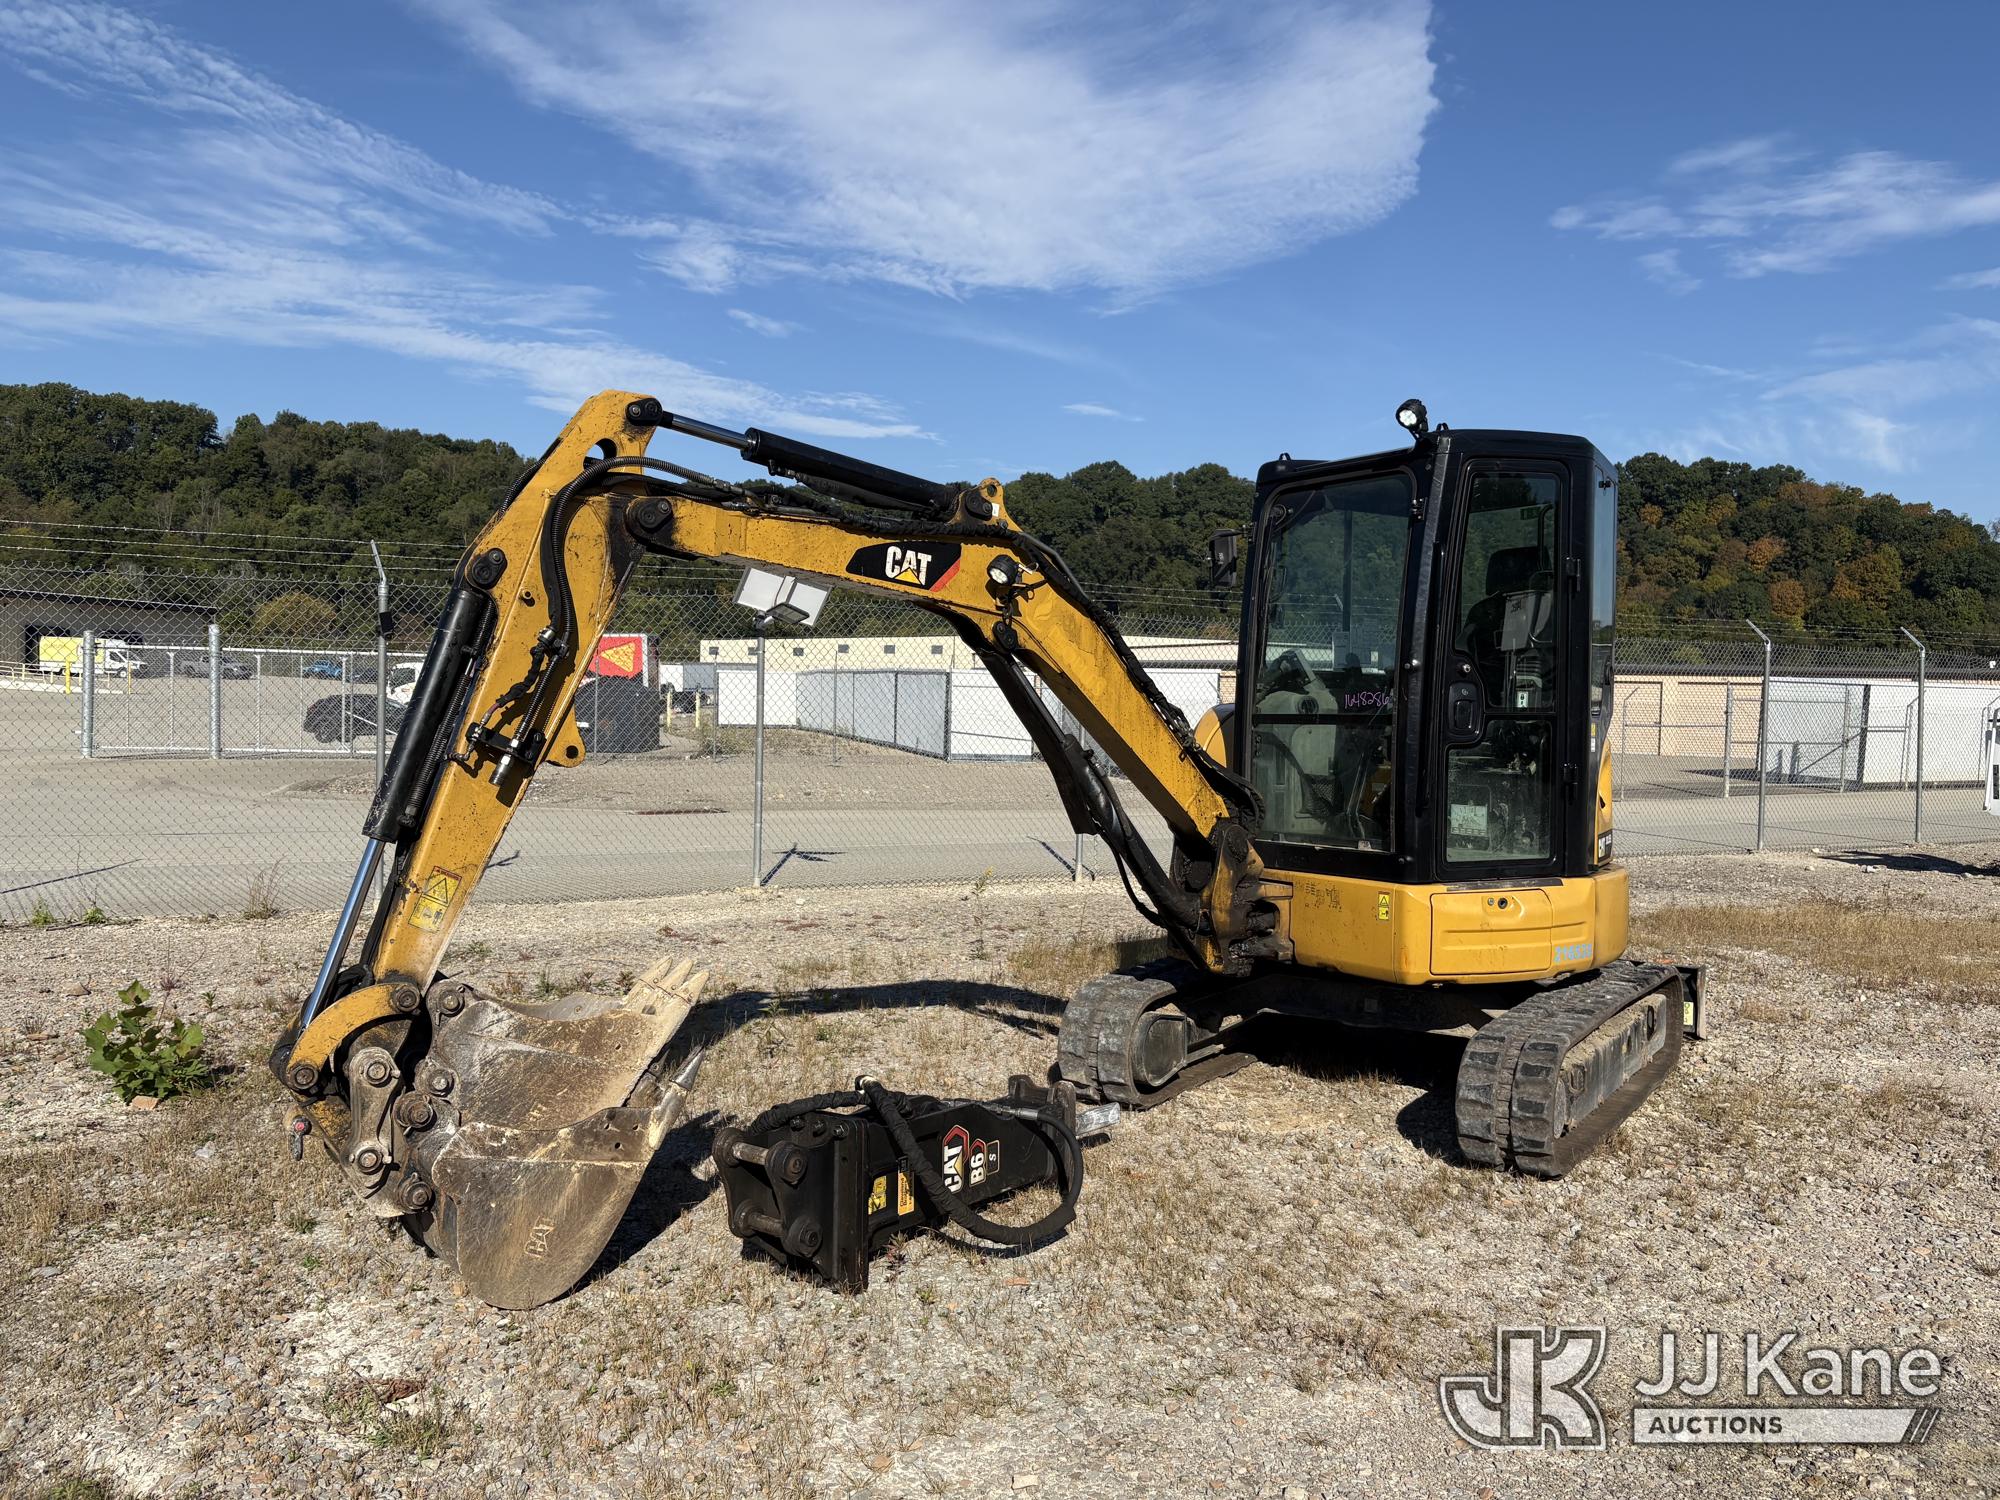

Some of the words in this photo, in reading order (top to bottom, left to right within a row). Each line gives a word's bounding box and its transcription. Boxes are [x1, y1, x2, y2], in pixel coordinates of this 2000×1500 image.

[885, 545, 932, 586] CAT
[944, 1145, 963, 1193] CAT
[970, 1152, 985, 1185] B6
